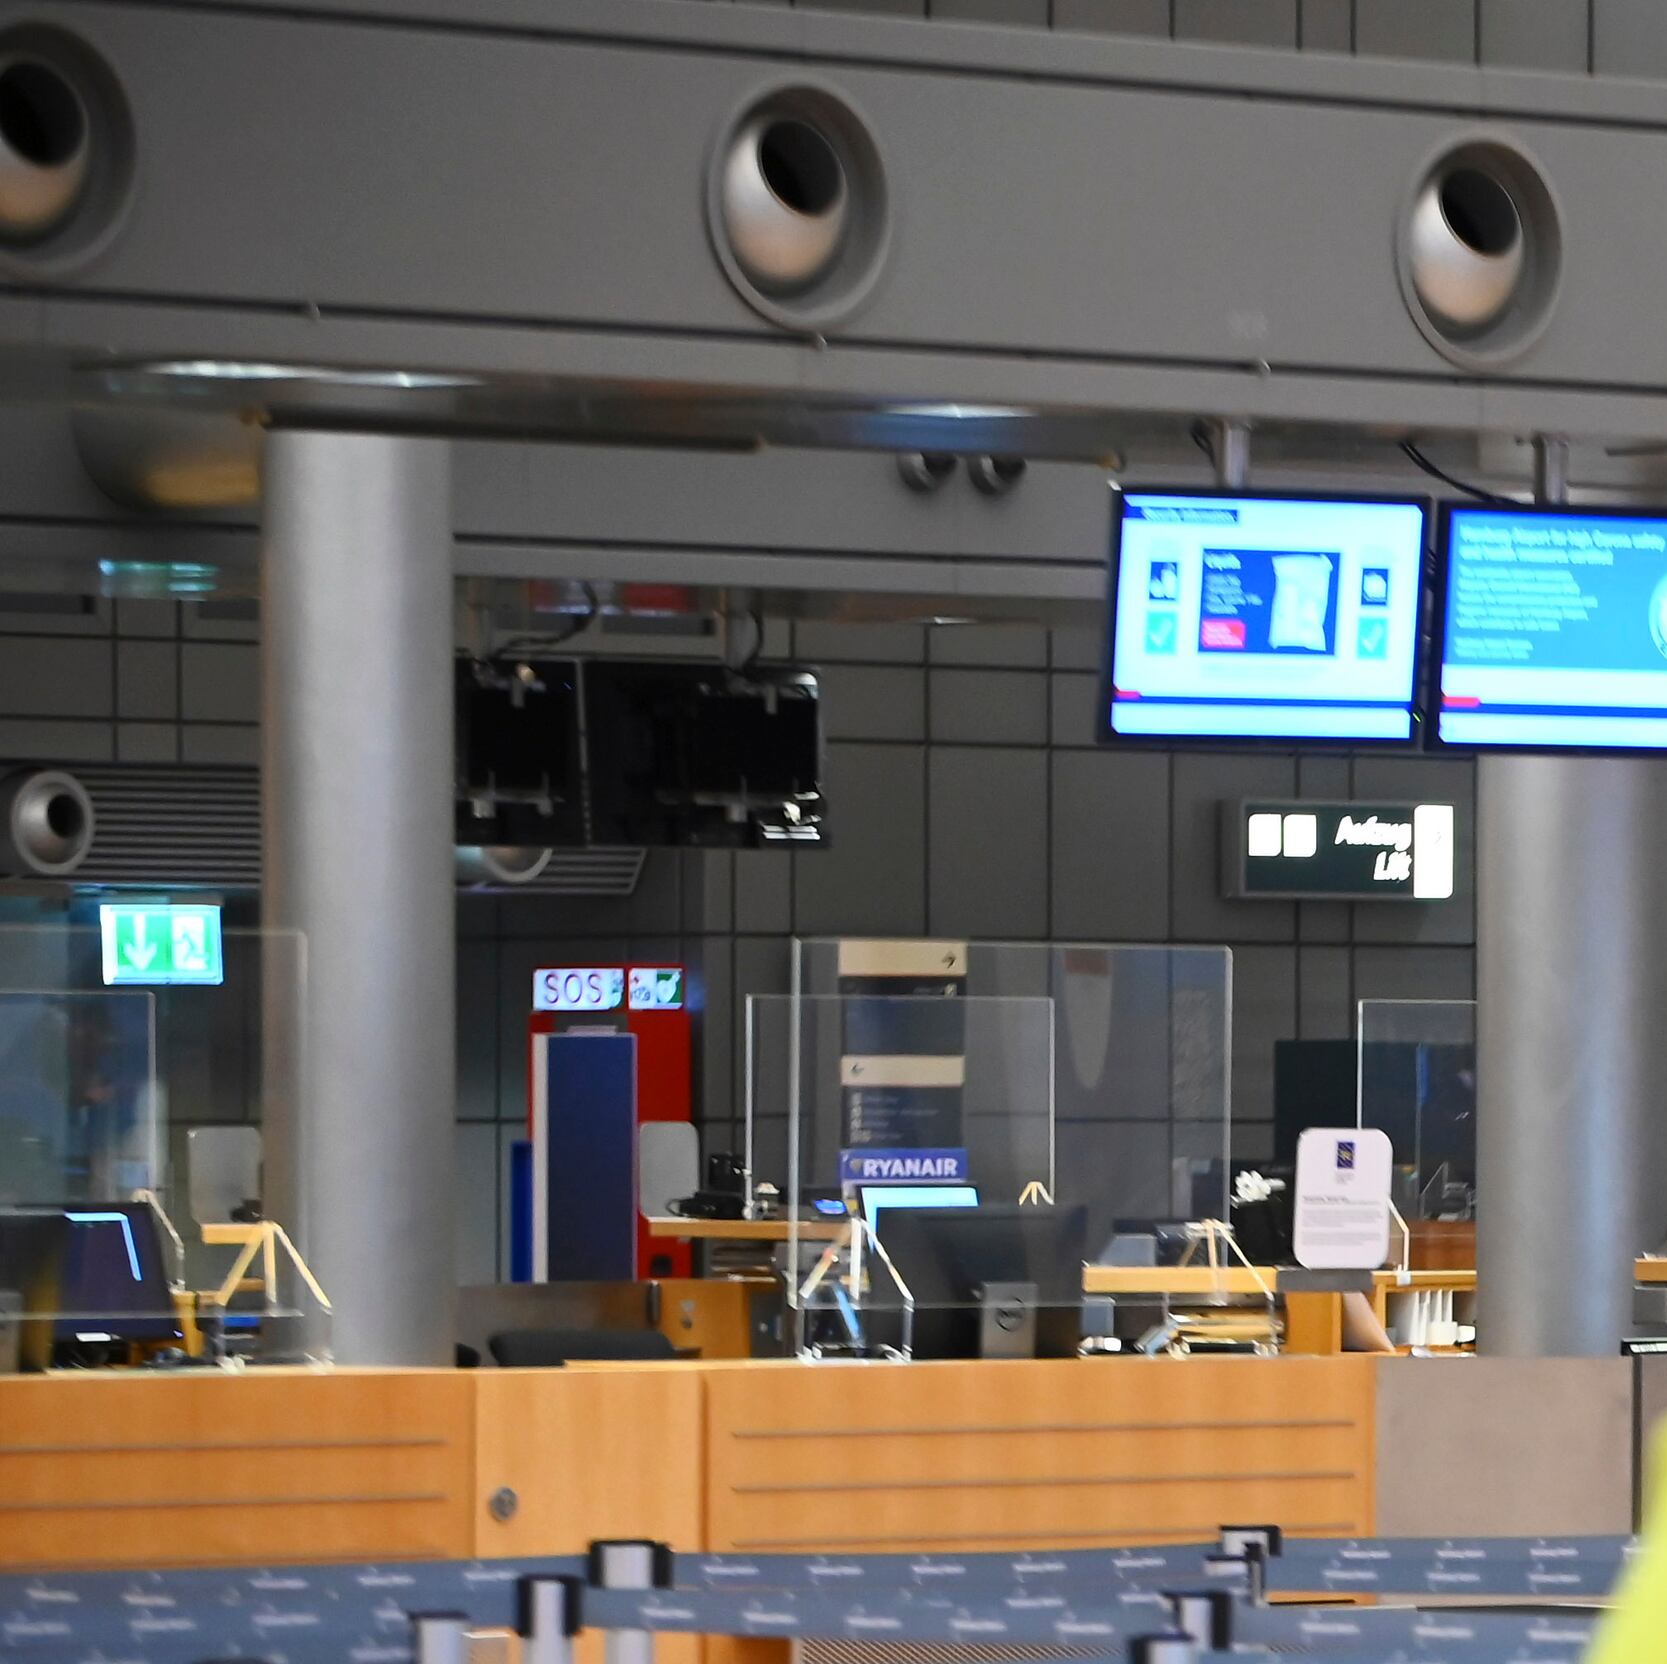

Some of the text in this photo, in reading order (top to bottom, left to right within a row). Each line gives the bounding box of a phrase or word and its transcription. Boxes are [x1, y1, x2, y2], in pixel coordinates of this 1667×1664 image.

[1334, 815, 1412, 851] Aufzug
[1373, 850, 1412, 881] Lift
[544, 973, 603, 1004] SOS
[863, 1158, 958, 1178] RYANAIR
